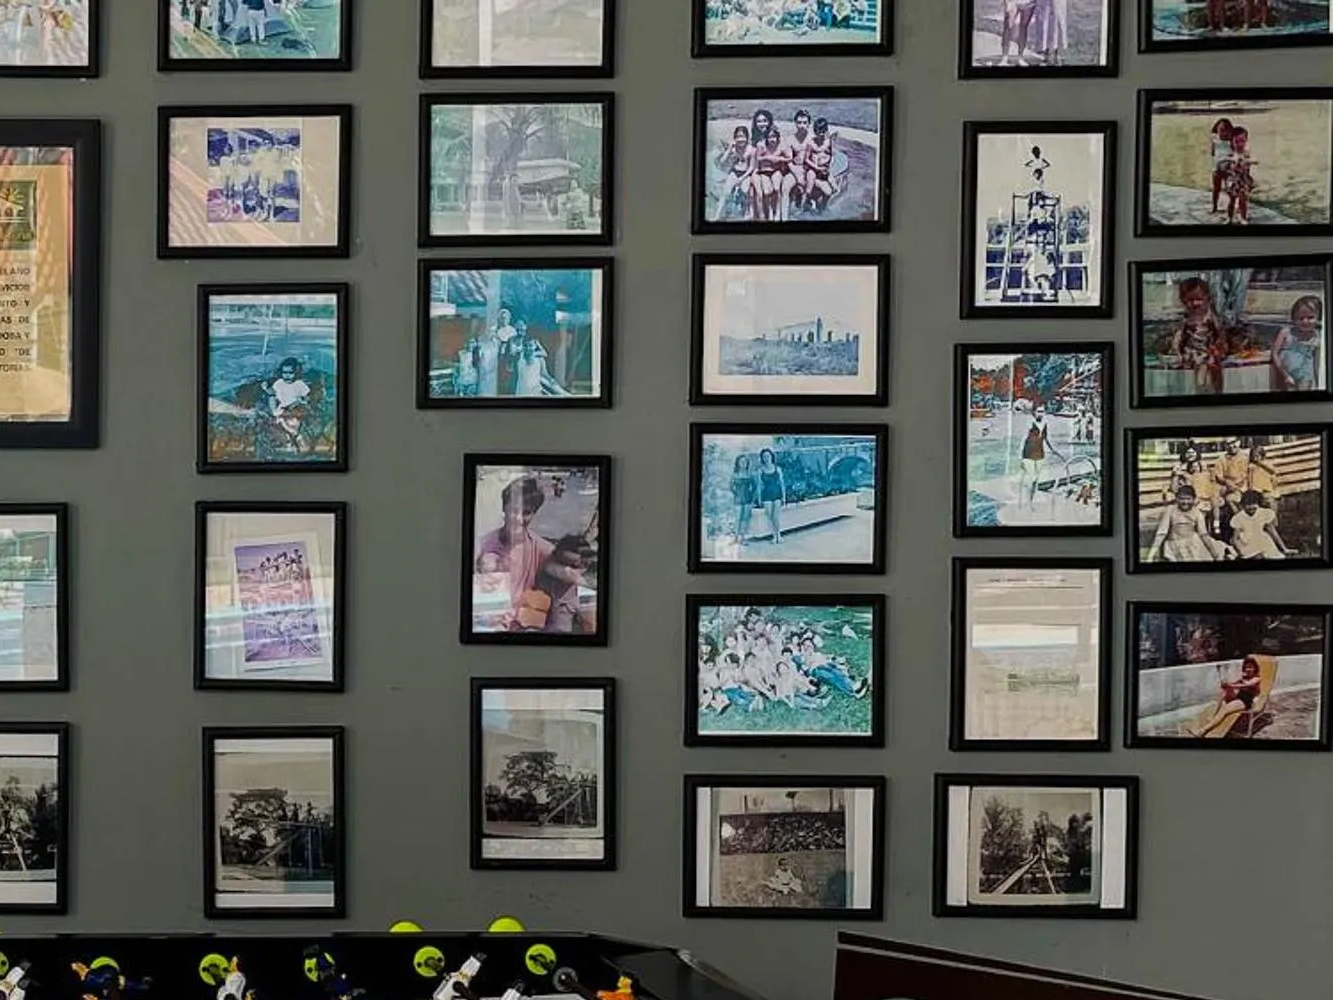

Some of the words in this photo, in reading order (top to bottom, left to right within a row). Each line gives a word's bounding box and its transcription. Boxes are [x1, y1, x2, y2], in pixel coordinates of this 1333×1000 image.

[23, 299, 30, 309] Y
[18, 315, 30, 324] DE
[23, 331, 30, 341] Y
